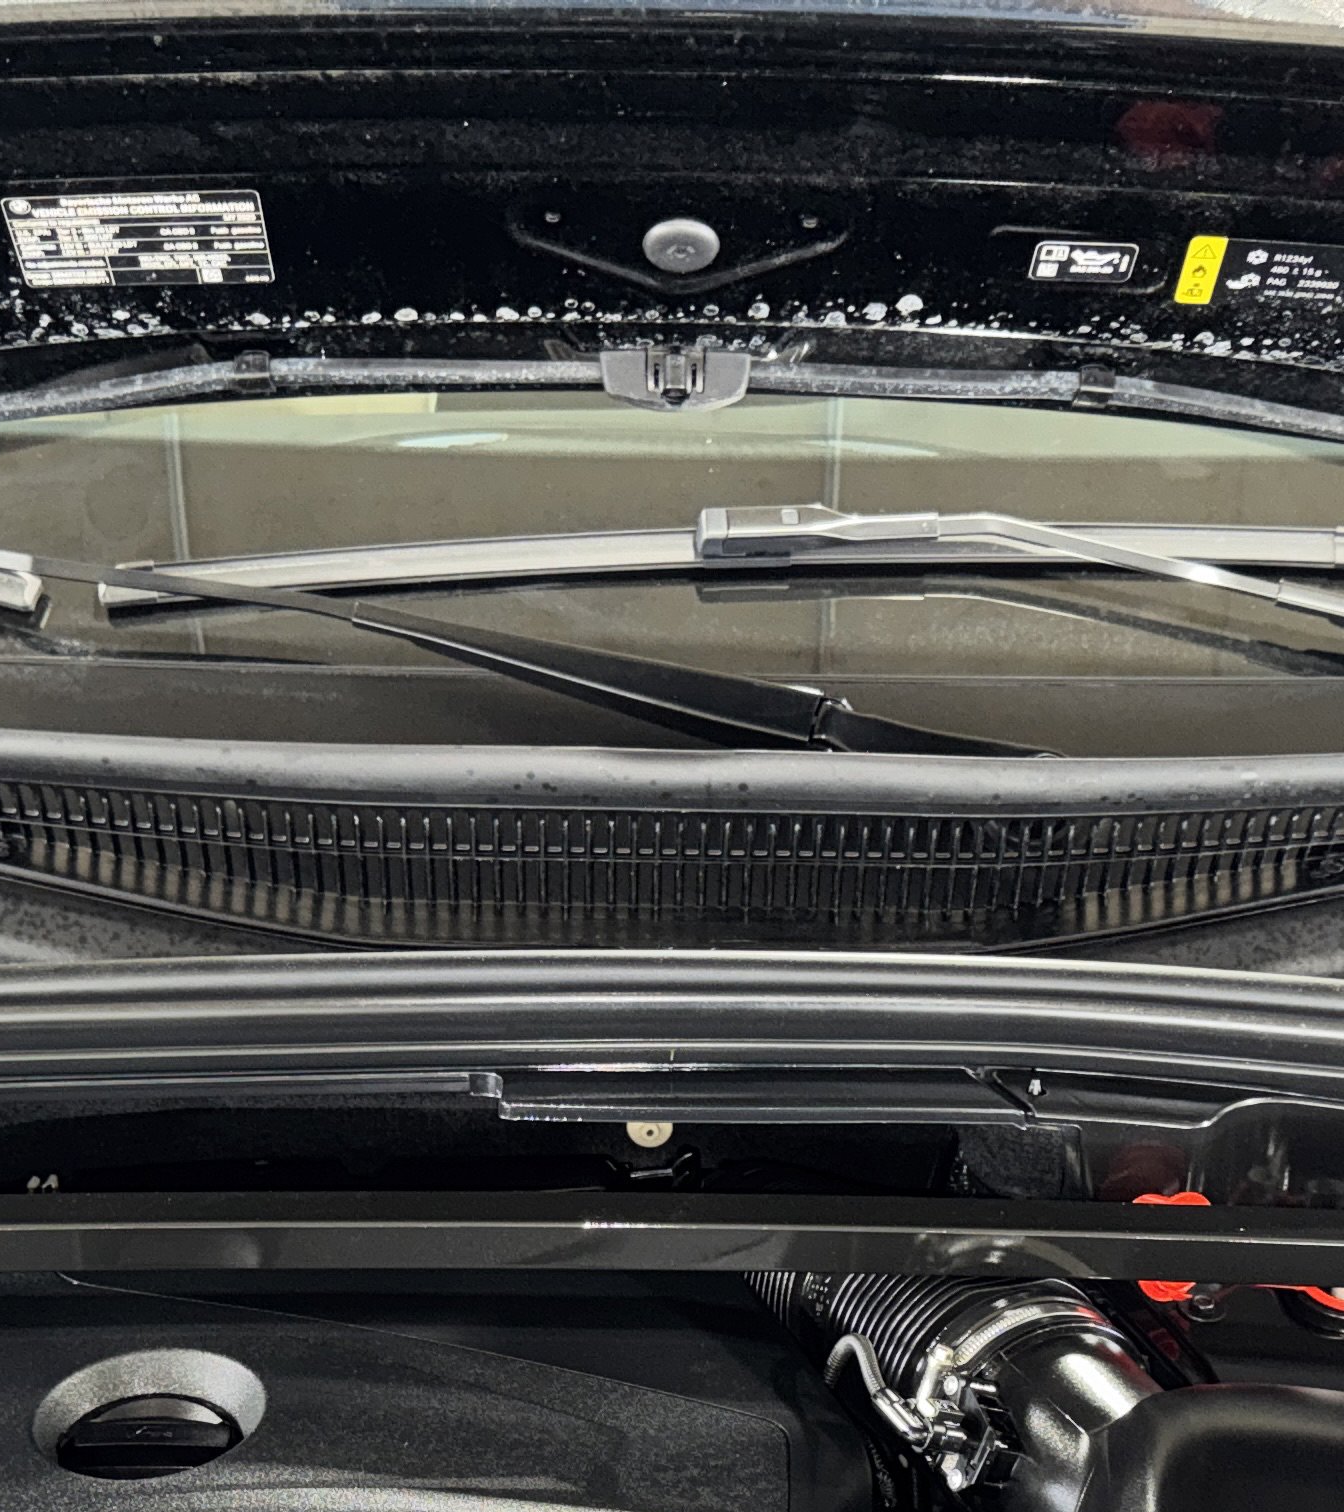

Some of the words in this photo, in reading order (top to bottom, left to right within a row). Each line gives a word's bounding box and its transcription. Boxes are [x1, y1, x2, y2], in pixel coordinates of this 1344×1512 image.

[31, 207, 76, 219] VEHICLE
[76, 205, 129, 217] EMISSION
[129, 204, 180, 215] CONTROL
[180, 201, 255, 213] INFORMATION
[1273, 253, 1314, 265] R1234yf
